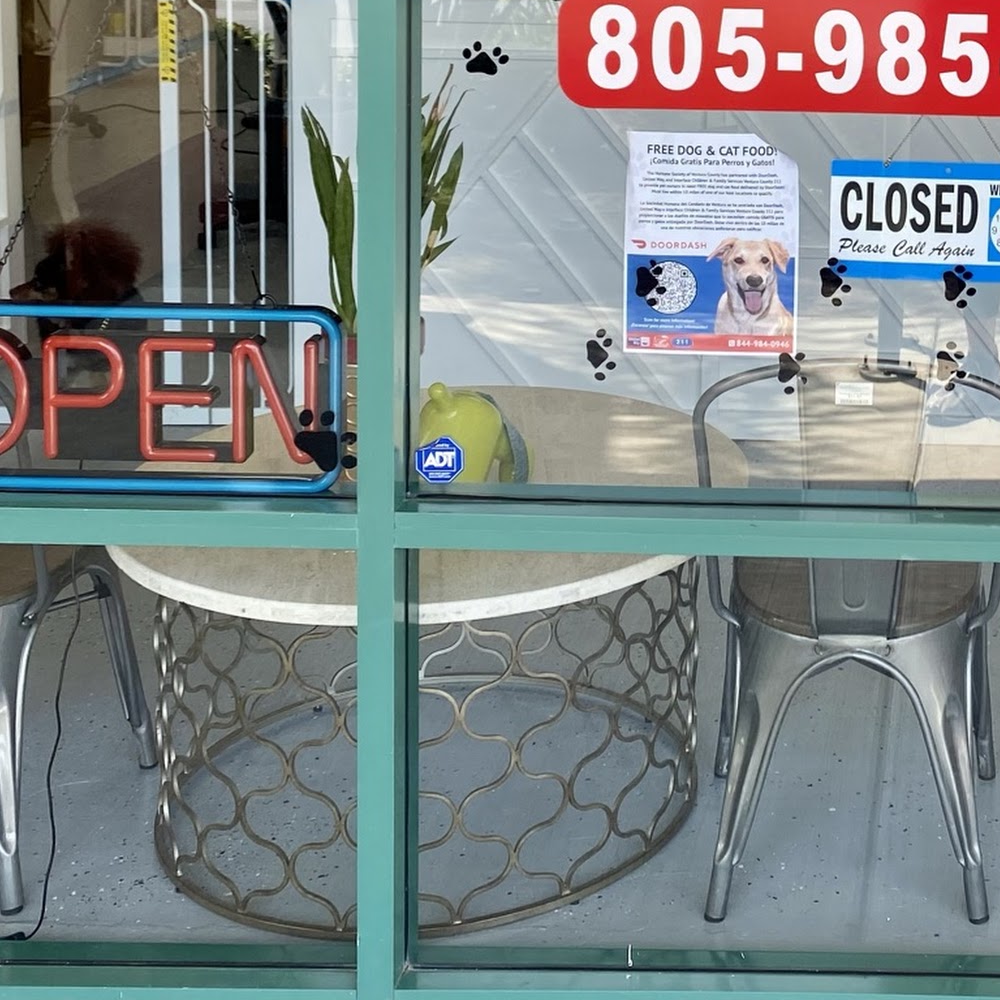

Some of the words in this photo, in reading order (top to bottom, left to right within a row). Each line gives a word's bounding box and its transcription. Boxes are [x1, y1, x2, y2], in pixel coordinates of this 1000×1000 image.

[647, 144, 674, 155] FREE
[677, 145, 702, 156] DOG
[706, 146, 715, 156] &
[719, 146, 740, 156] CAT
[742, 146, 778, 157] FOOD!
[704, 158, 720, 166] Para
[722, 159, 744, 167] Perros
[840, 180, 979, 234] CLOSED
[650, 241, 707, 249] DOORDASH
[838, 237, 886, 254] Please
[892, 239, 926, 257] Call
[928, 241, 976, 261] Again
[421, 451, 455, 468] ADT
